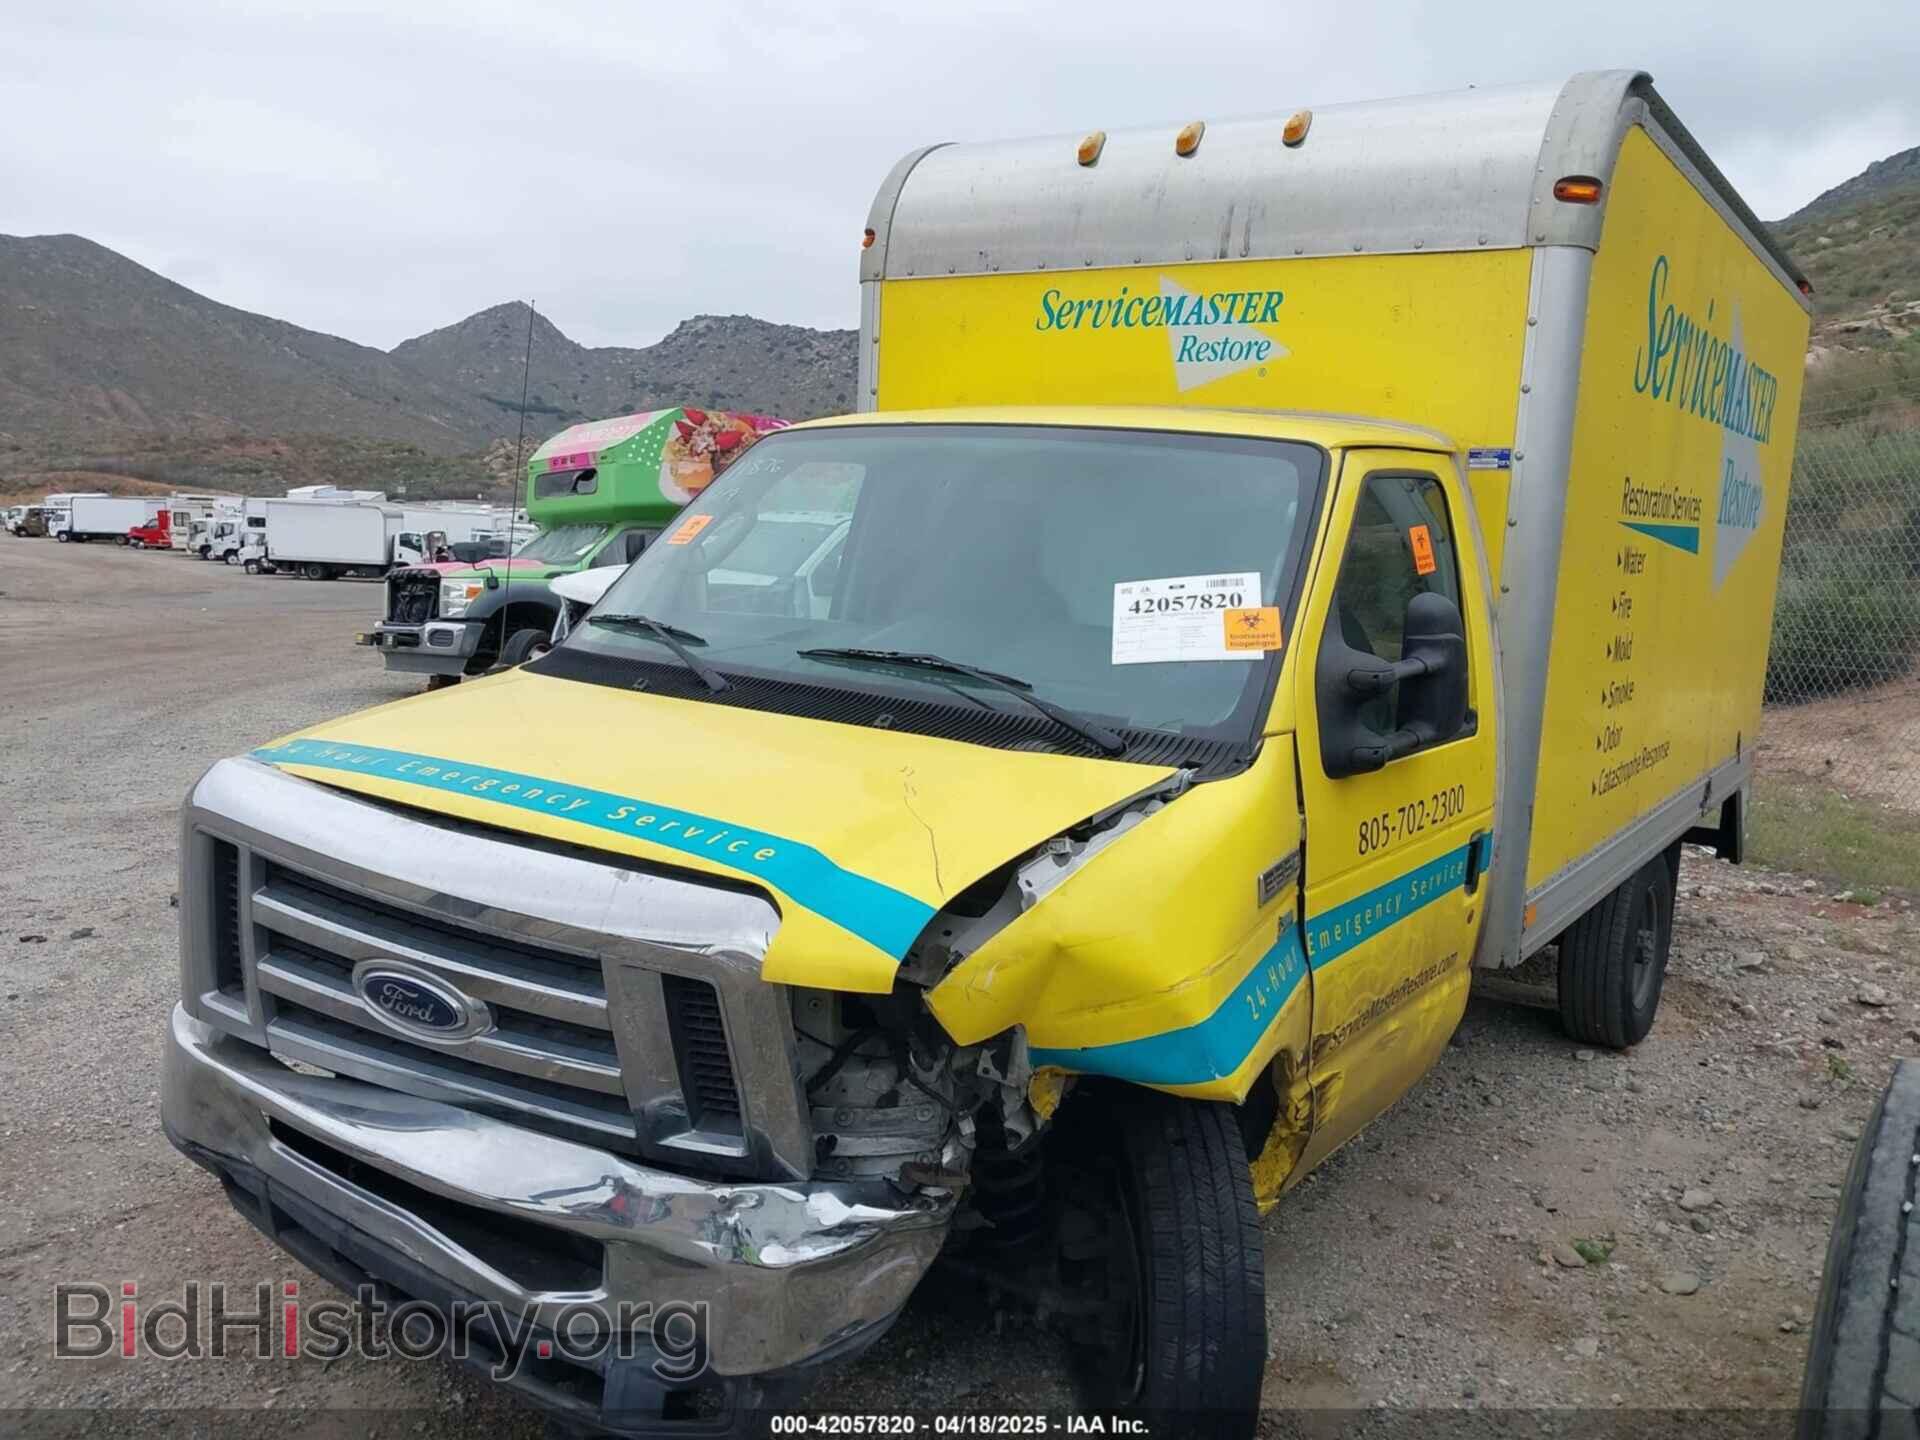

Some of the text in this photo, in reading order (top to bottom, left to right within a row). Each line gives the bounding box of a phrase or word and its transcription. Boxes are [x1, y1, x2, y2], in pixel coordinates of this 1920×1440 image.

[1176, 335, 1272, 363] Restore
[1622, 476, 1702, 521] Restoration Services
[1716, 458, 1762, 531] Restore
[1622, 546, 1647, 575] Water
[1128, 592, 1243, 614] 42057820
[1617, 591, 1633, 620] Fire
[1612, 633, 1634, 663] Mold
[1607, 674, 1635, 709] Smoke
[1603, 720, 1624, 753] Odor
[396, 759, 591, 811] Emergency
[607, 804, 778, 862] Service
[1358, 784, 1465, 855] 805-702-2300
[1246, 858, 1464, 1021] 24-Hour Emergency Service
[380, 983, 434, 1022] Ford
